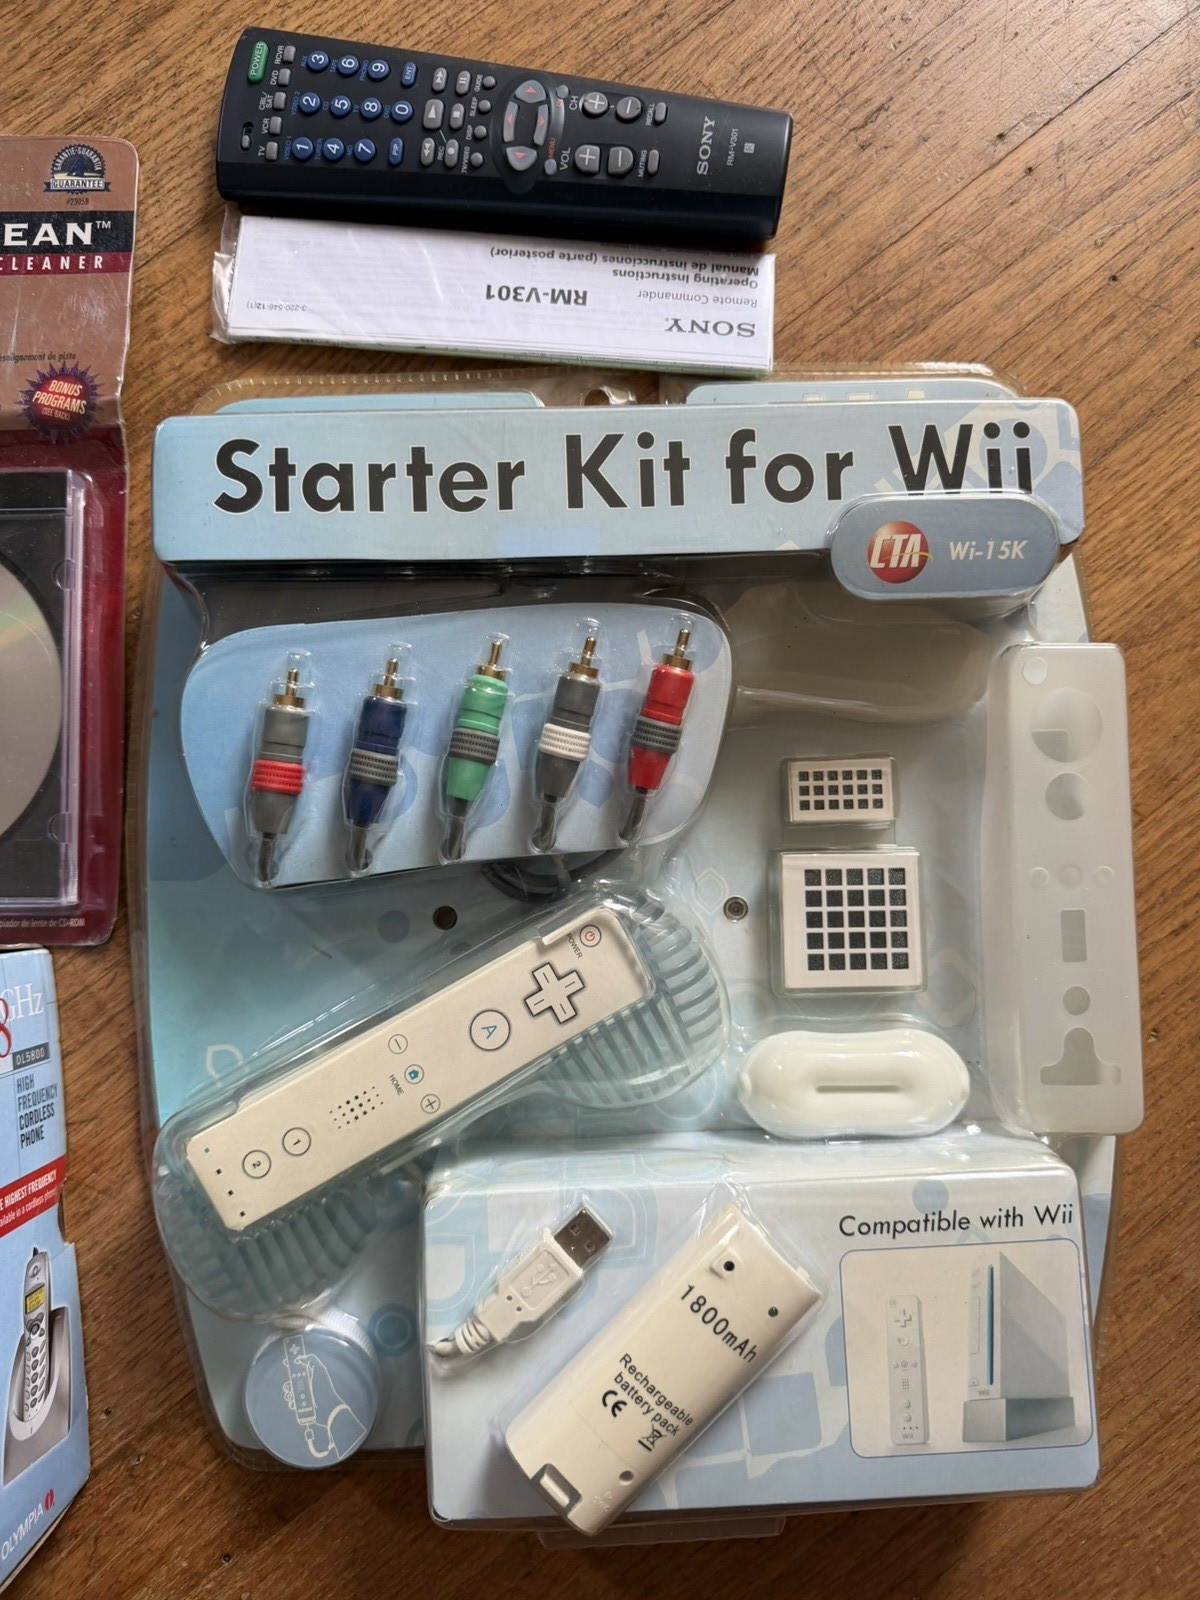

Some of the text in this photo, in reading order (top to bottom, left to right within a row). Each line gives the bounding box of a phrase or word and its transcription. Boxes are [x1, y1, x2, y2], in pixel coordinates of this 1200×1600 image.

[250, 42, 265, 75] POWER
[274, 45, 285, 64] RCVR
[311, 54, 325, 64] 3
[341, 58, 356, 68] 6
[372, 62, 386, 73] 9
[404, 66, 414, 80] ENT
[270, 69, 279, 85] DVD
[474, 74, 483, 92] GUIDE
[259, 91, 268, 110] CBL/
[266, 94, 274, 108] SAT
[302, 96, 316, 107] 2
[334, 99, 348, 110] 5
[364, 101, 378, 112] 8
[395, 104, 409, 114] 0
[470, 96, 478, 117] SLEEP
[569, 95, 579, 110] CH
[646, 103, 656, 126] RECALL
[258, 146, 266, 156] TV
[296, 142, 309, 151] 1
[327, 143, 340, 154] 4
[358, 143, 371, 154] 7
[392, 143, 400, 156] PIP
[548, 138, 556, 158] MENU
[696, 116, 716, 176] SONY
[726, 128, 739, 166] RM-V301
[560, 147, 571, 171] VOL
[638, 149, 648, 178] MUTING
[52, 179, 102, 188] GUARANTEE
[490, 246, 555, 260] posterior)
[558, 250, 598, 264] (parte
[602, 254, 687, 269] instrucciones
[691, 260, 707, 272] de
[710, 262, 760, 277] Manual
[612, 268, 759, 290] Operating Instructions
[486, 284, 588, 306] RM-V301
[637, 290, 758, 308] Remote Commander
[665, 317, 756, 338] SONY
[49, 380, 82, 397] BONUS
[32, 391, 87, 414] PROGRAMS
[212, 420, 1033, 514] Starter Kit for Wii
[870, 533, 1028, 569] CTA Wi-15K
[59, 918, 86, 927] CD-ROM
[566, 933, 583, 960] POWER
[481, 1024, 498, 1040] A
[16, 1073, 35, 1094] HIGH
[388, 1074, 404, 1096] HOME
[18, 1082, 58, 1113] FREQUENCY
[19, 1102, 56, 1131] CORDLESS
[20, 1124, 45, 1150] PHONE
[252, 1160, 262, 1169] 2
[4, 1184, 28, 1208] HIGHEST
[28, 1168, 58, 1196] FREQUENCY
[26, 1196, 45, 1212] cordless
[839, 1203, 1074, 1240] Compatible with Wii
[680, 1284, 758, 1364] 1800mAh
[619, 1353, 694, 1426] Rechargeable
[614, 1371, 680, 1436] battery pack
[1, 1502, 44, 1560] OLYMPIA
